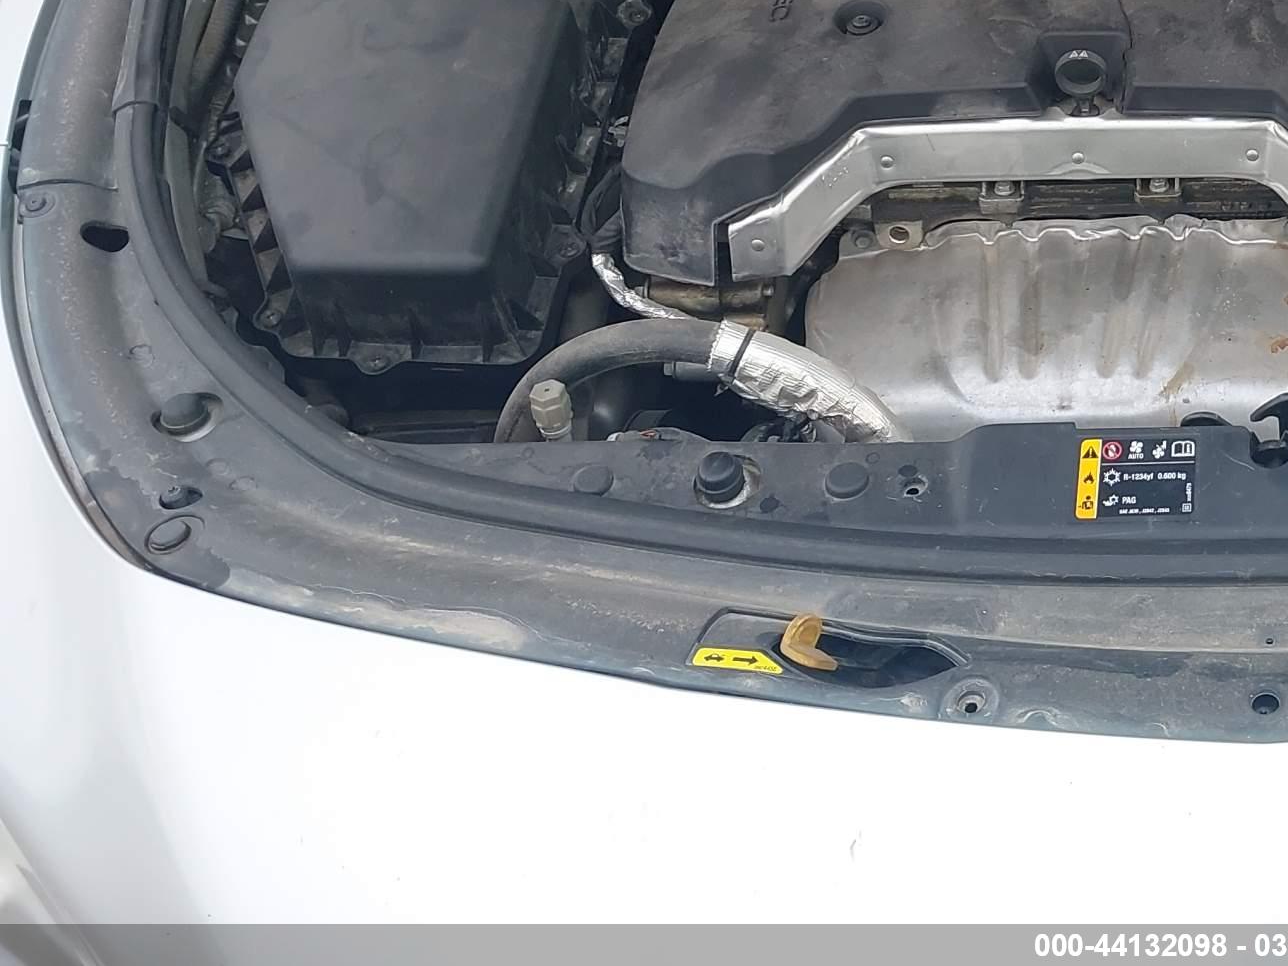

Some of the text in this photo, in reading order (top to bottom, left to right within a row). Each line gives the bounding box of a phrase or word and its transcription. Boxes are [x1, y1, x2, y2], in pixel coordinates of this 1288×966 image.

[1123, 471, 1187, 481] R-1234yf 0.600 kg
[1122, 496, 1137, 504] PAG
